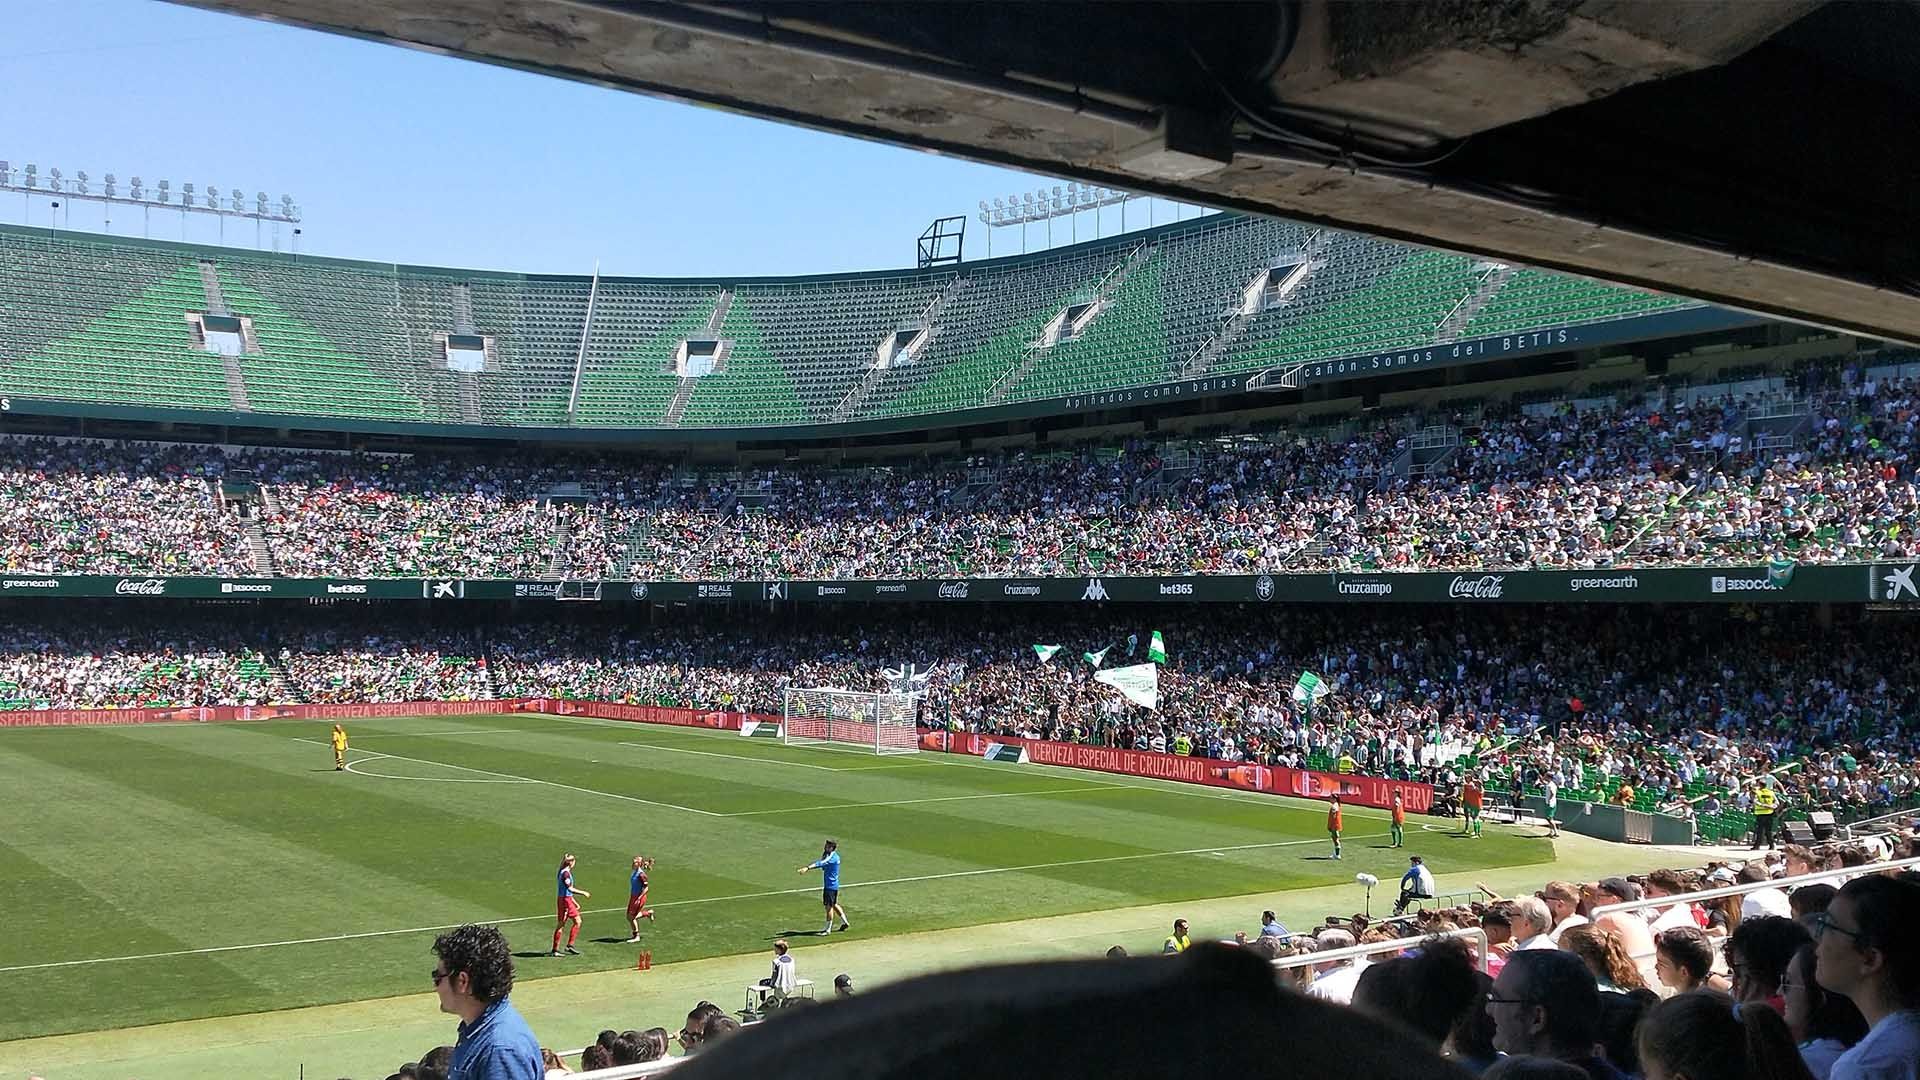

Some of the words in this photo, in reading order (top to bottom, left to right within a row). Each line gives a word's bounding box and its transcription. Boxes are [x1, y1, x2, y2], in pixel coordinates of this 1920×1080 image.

[1065, 392, 1133, 408] Apiñados
[1144, 386, 1181, 398] como
[1193, 378, 1238, 392] balas
[1452, 341, 1484, 357] del
[3, 579, 59, 588] greenearth
[327, 584, 367, 593] bet365
[1160, 584, 1193, 594] bet365
[1338, 580, 1392, 596] Cruzcampo
[1570, 575, 1638, 591] greenearth
[52, 711, 65, 725] DE
[71, 711, 145, 725] CRUZCAMPO
[304, 706, 319, 719] LA
[323, 705, 370, 719] CERVEZA
[374, 704, 422, 718] ESPECIAL
[425, 703, 437, 716] DE
[440, 702, 503, 716] CRUZCAMPO
[588, 703, 597, 716] LA
[597, 704, 620, 718] CERVEZA
[656, 709, 693, 724] CRUZCAMPO
[1034, 743, 1074, 765] CERVEZA
[1077, 749, 1121, 771] ESPECIAL
[1124, 754, 1136, 772] DE
[1139, 756, 1204, 781] CRUZCAMPO
[1372, 782, 1390, 805] LA
